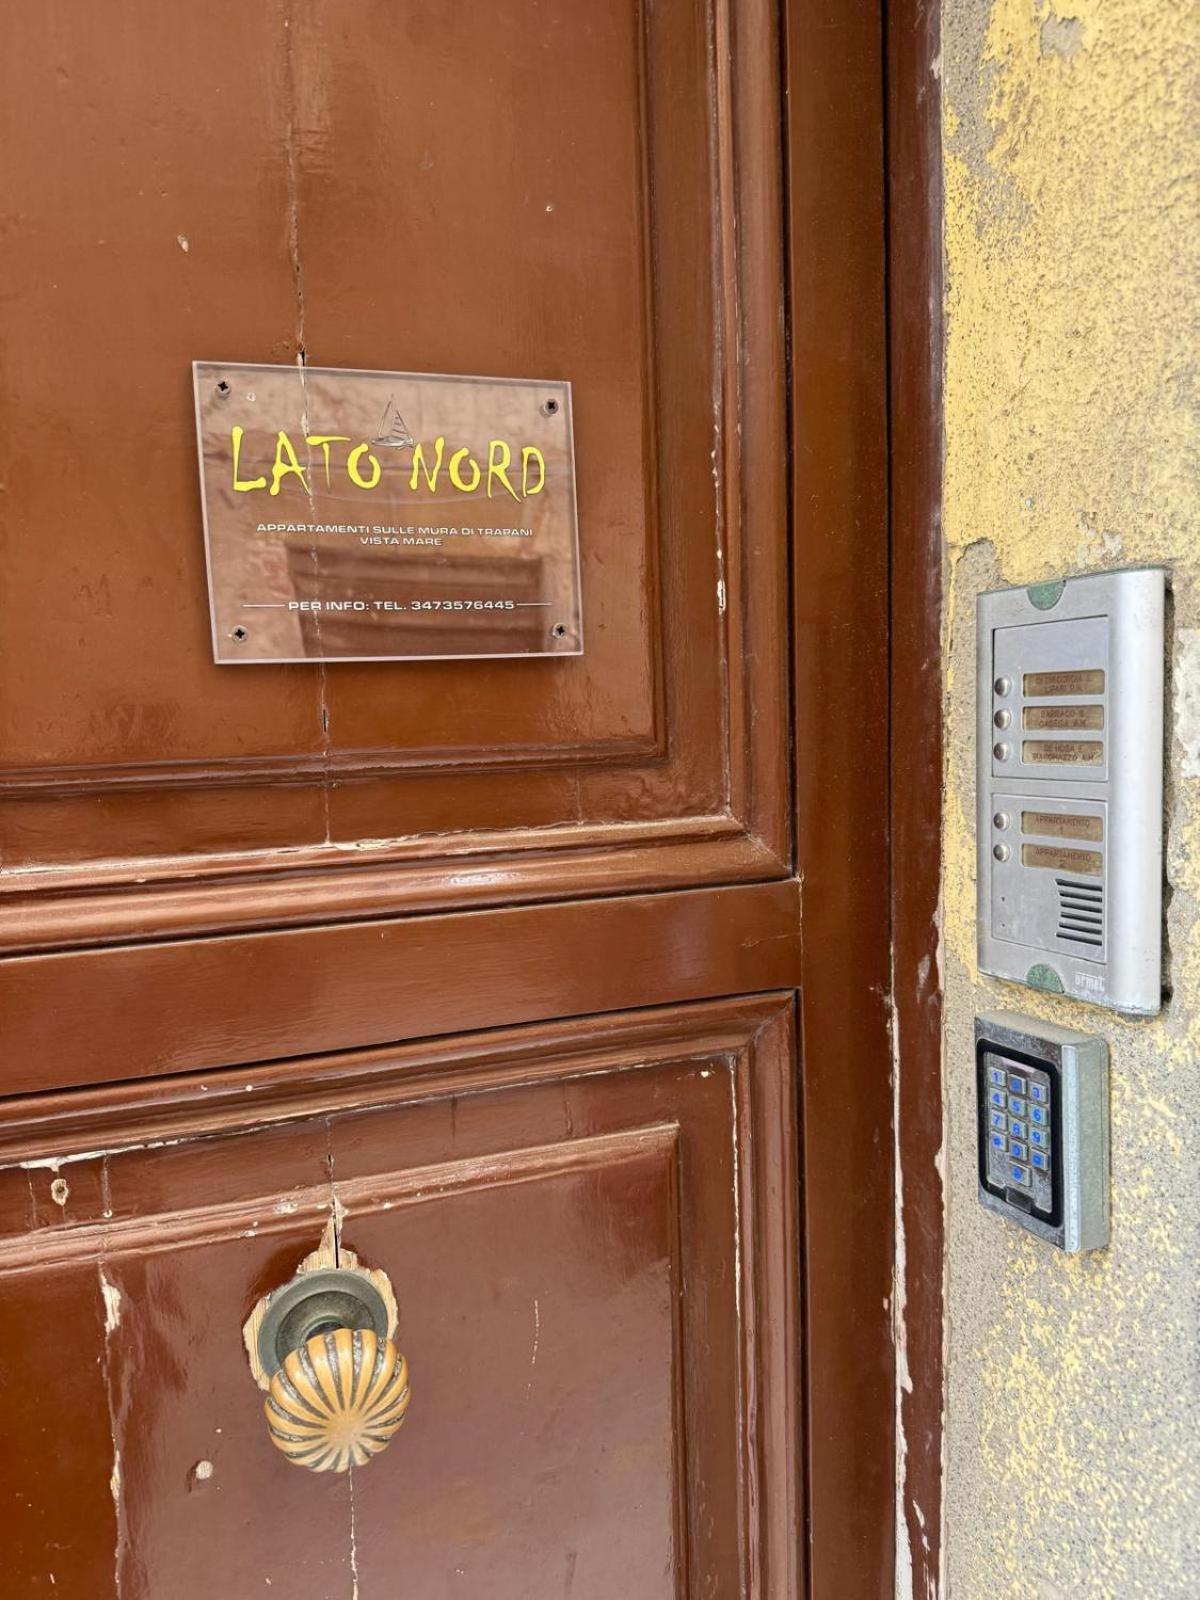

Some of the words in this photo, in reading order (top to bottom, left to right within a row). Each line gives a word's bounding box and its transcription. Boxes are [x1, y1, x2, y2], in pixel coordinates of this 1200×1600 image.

[231, 425, 382, 497] LATO
[409, 436, 546, 504] NORD
[256, 523, 370, 534] APPARTAMENTI
[373, 525, 415, 535] SULLE
[418, 526, 458, 536] MURA
[461, 527, 474, 536] DI
[477, 528, 533, 537] TRAPANI
[360, 537, 400, 545] VISTA
[403, 537, 443, 546] MARE
[288, 601, 322, 611] PER
[326, 601, 369, 611] INFO:
[373, 601, 406, 611] TEL.
[411, 600, 515, 611] 3473576445
